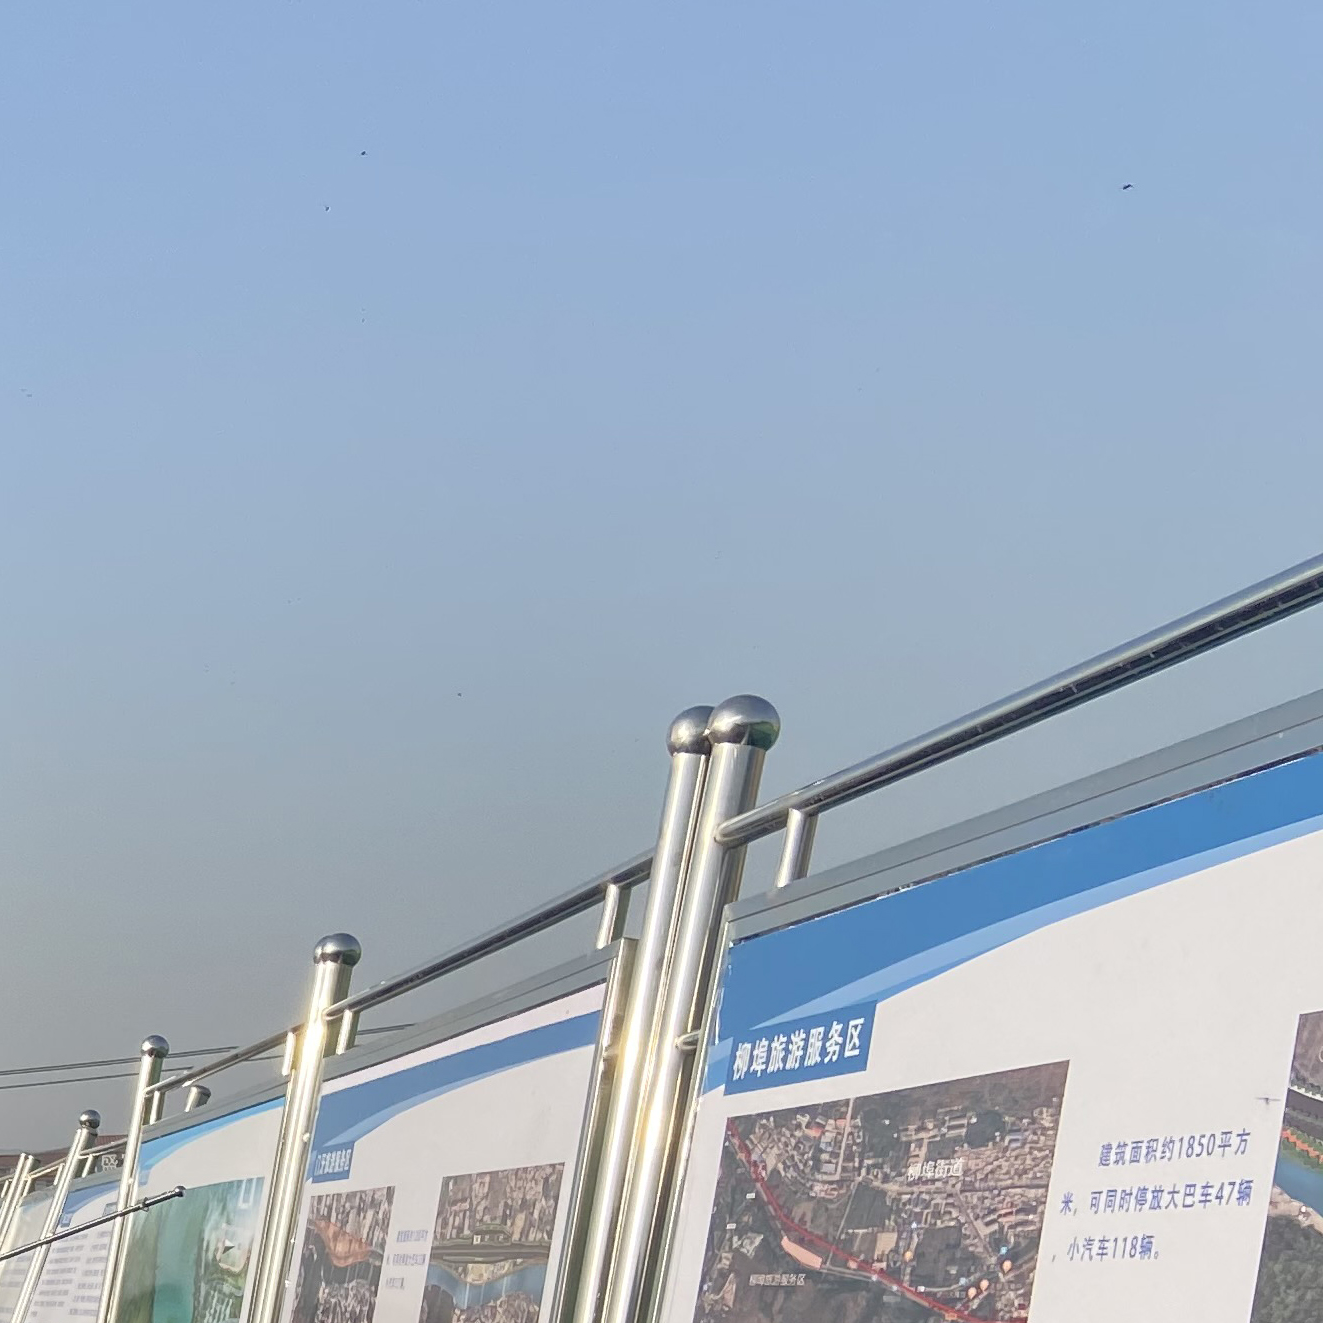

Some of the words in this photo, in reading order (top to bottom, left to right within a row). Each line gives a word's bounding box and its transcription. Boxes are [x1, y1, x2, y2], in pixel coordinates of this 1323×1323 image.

[732, 1017, 865, 1082] 柳埠旅游服务区
[1098, 1128, 1251, 1167] 建筑面积约1850平方
[907, 1158, 964, 1180] 柳埠街道
[1060, 1179, 1254, 1215] 米，可同时停放大巴车47辆
